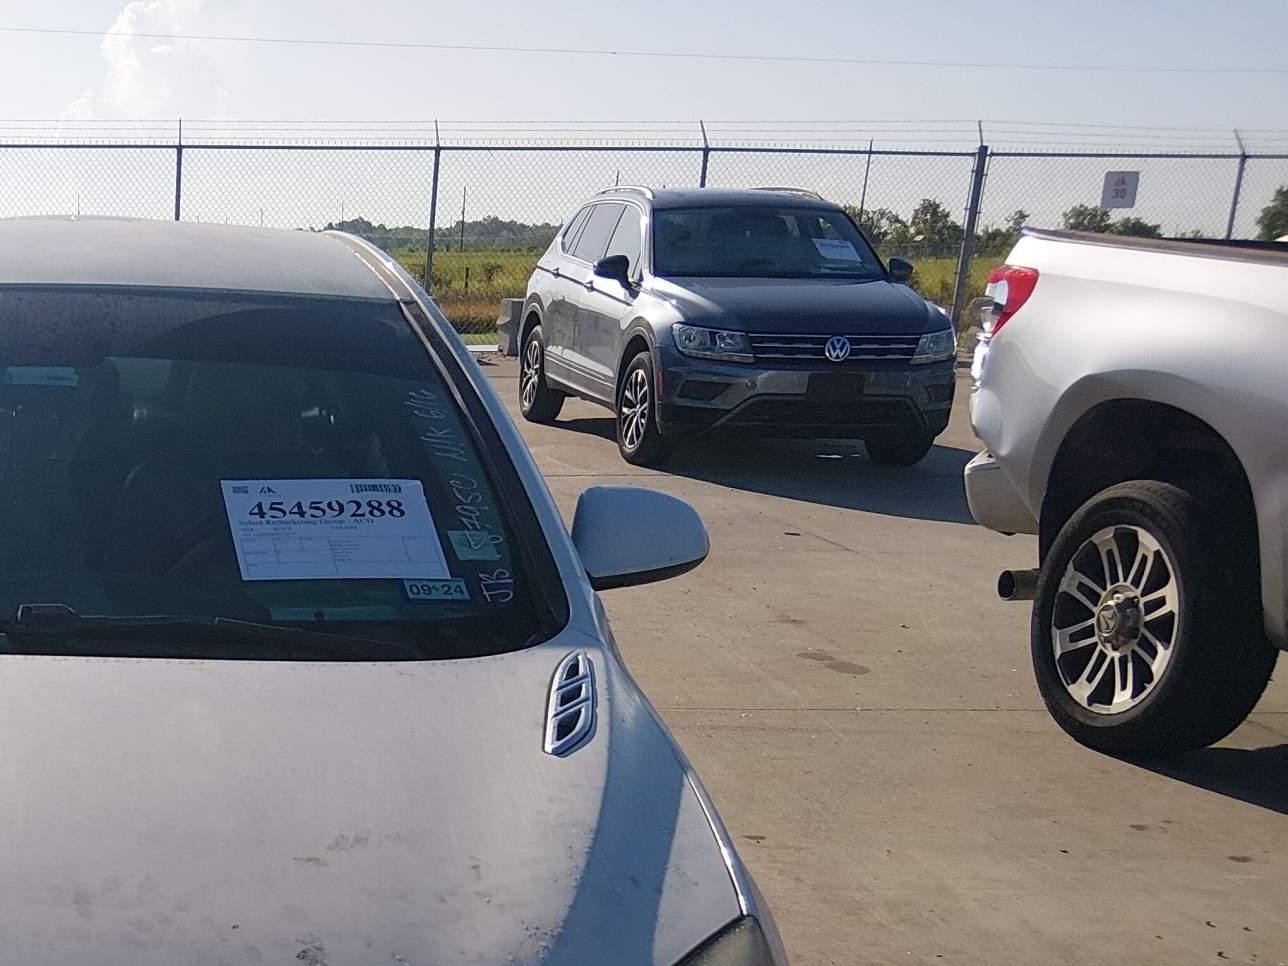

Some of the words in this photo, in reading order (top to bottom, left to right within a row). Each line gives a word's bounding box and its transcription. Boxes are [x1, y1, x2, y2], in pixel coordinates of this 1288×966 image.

[248, 499, 406, 519] 45459288
[408, 583, 432, 596] 09
[439, 583, 465, 596] 24
